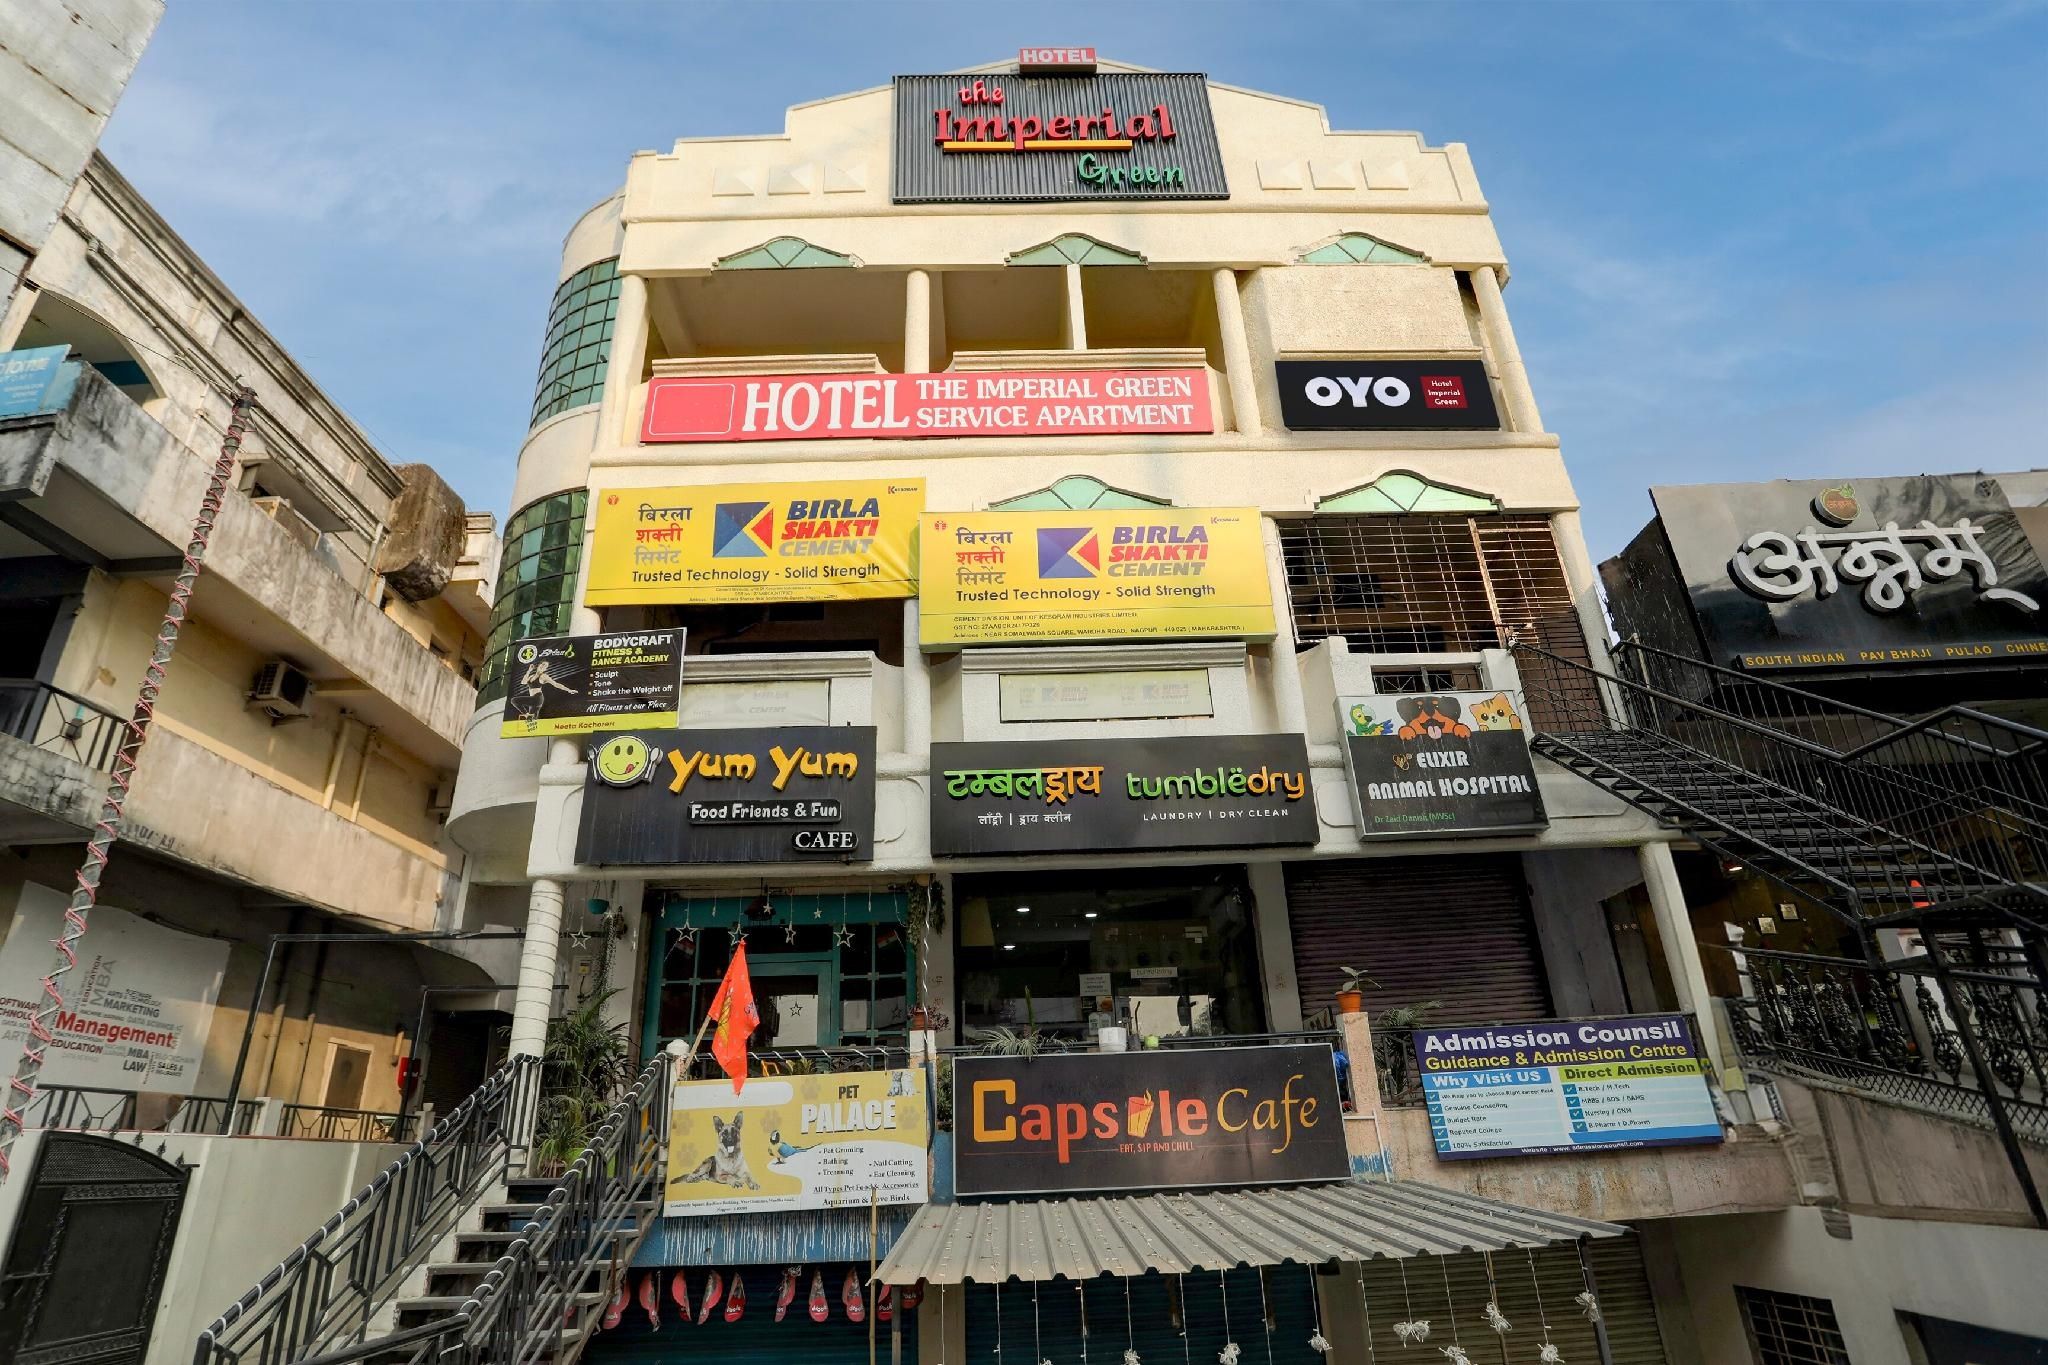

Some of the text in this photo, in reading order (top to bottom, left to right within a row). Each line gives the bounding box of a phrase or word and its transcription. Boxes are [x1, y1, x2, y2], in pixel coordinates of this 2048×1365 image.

[1022, 49, 1095, 63] HOTEL
[958, 80, 1004, 104] the
[934, 104, 1176, 150] Imperial
[1078, 153, 1184, 184] Green
[916, 376, 1191, 400] THE IMPERIAL GREEN
[1304, 376, 1411, 408] OYO
[1428, 389, 1461, 397] Imperial
[742, 380, 910, 432] HOTEL
[1434, 398, 1459, 406] Green
[916, 404, 1193, 428] SERVICE APARTMENT
[638, 503, 692, 522] बिरला
[786, 498, 880, 521] BIRLA
[780, 520, 879, 540] SHAKTI
[956, 527, 1013, 546] बिरला
[1112, 525, 1208, 545] BIRLA
[634, 545, 681, 566] सिमेंट
[778, 539, 874, 557] CEMENT
[1108, 545, 1208, 562] SHAKTI
[632, 563, 881, 583] Trusted Technology Solid Strength
[956, 565, 1006, 587] सिमेंट
[1107, 562, 1206, 577] CEMENT
[956, 584, 1216, 603] Trusted Technology Solid Strength
[593, 634, 674, 650] BODYCRAFT
[591, 654, 670, 666] DANCE ACADEMY
[593, 647, 643, 658] FITNESS &
[1745, 655, 1793, 667] SOUTH
[1797, 652, 1845, 664] INDIAN
[1860, 650, 1886, 661] PAV
[1890, 648, 1932, 660] BHAJI
[1946, 645, 1993, 657] PULAO
[595, 670, 619, 679] Sculpt
[632, 686, 661, 695] Weight
[662, 684, 673, 692] off
[1416, 750, 1470, 769] ELIXIR
[667, 745, 859, 794] Yum Yum
[1368, 774, 1531, 800] ANIMAL HOSPITAL
[691, 802, 838, 819] Food Friends & Fun
[1143, 808, 1289, 822] LAUNDRY DRY CLEAN
[795, 831, 853, 848] CAFE
[103, 998, 160, 1019] MARKETING
[55, 1010, 174, 1048] Management
[1424, 1021, 1681, 1053] Admission Counsil
[50, 1038, 103, 1054] EDUCATION
[127, 1047, 150, 1059] MBA
[123, 1059, 148, 1073] LAW
[1425, 1043, 1687, 1070] Guidance & Admission Centre
[1432, 1070, 1541, 1091] Why Visit US
[1564, 1062, 1695, 1080] Direct Admission
[838, 1085, 859, 1099] PET
[800, 1099, 897, 1135] PALACE
[1217, 1074, 1319, 1154] Cafe
[1119, 1141, 1195, 1154] EAT, SIP AND CHILL
